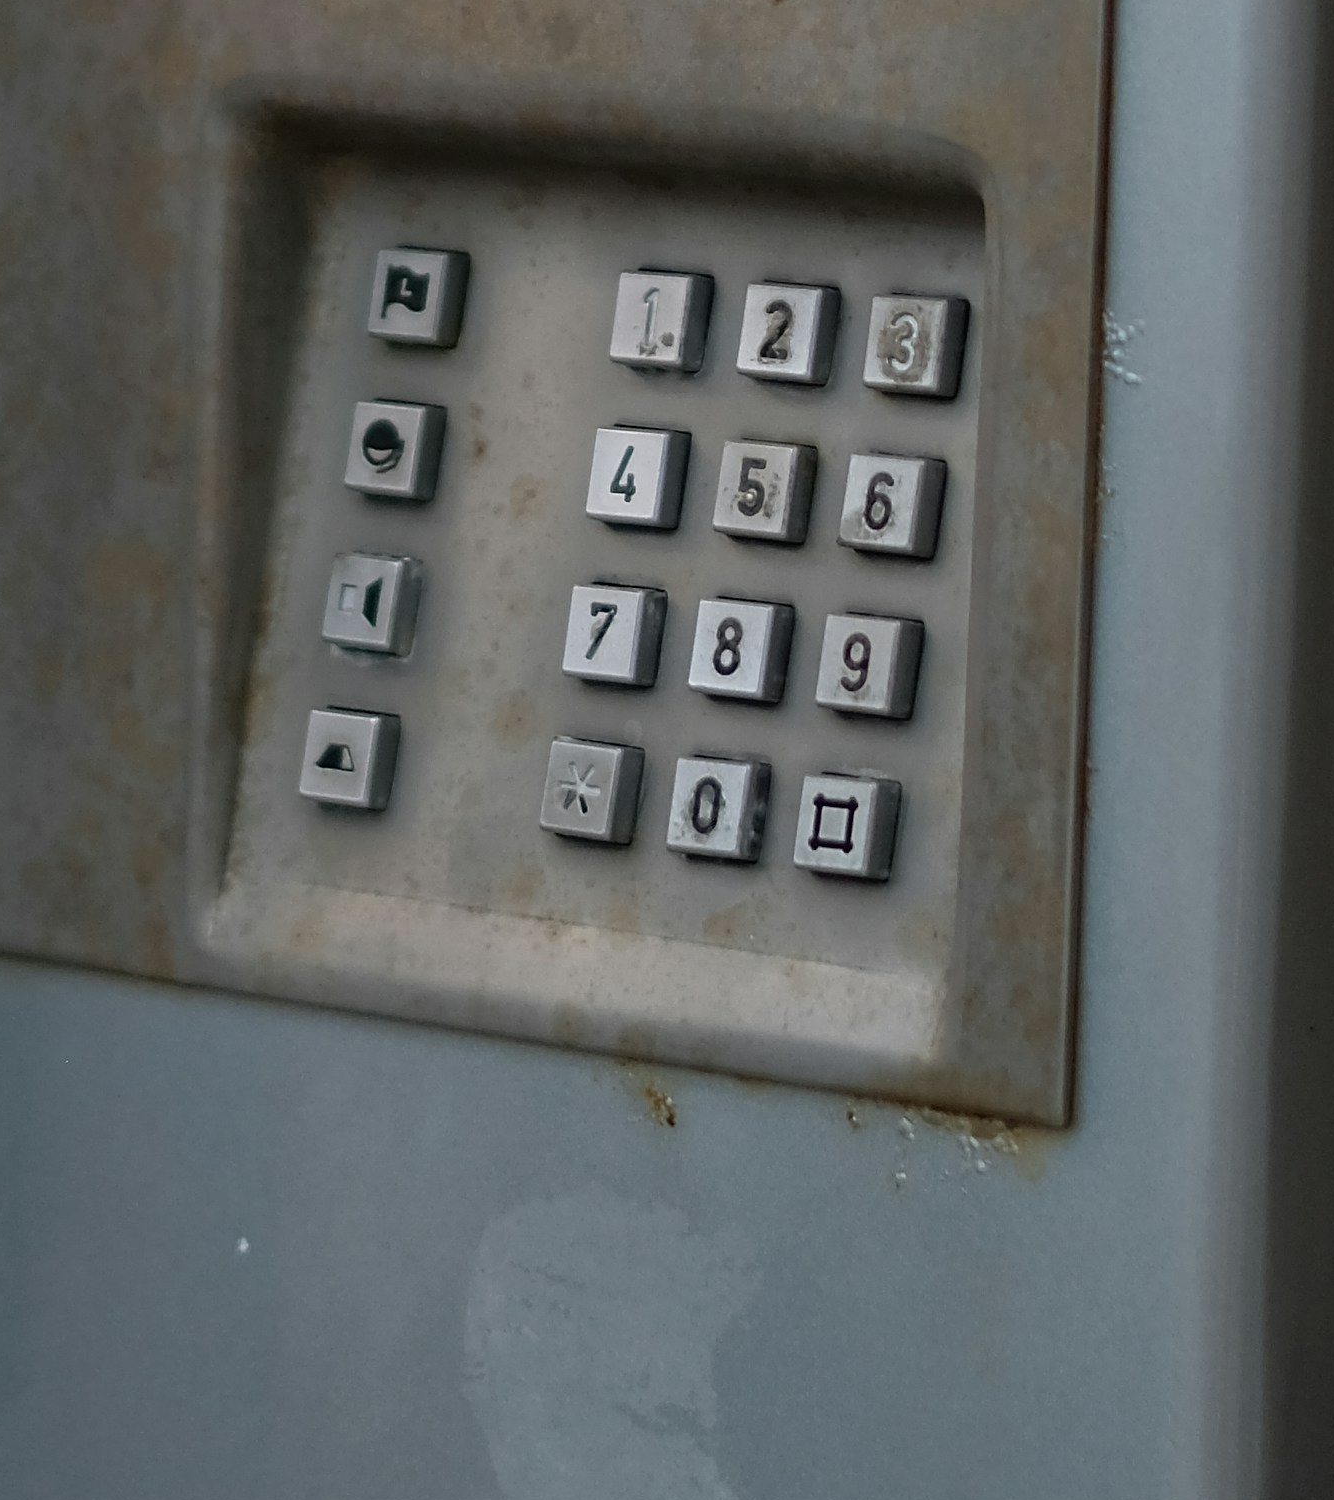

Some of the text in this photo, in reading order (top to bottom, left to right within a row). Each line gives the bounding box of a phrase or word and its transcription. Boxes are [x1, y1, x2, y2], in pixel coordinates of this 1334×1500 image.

[639, 287, 920, 373] 1 2 3
[610, 445, 895, 531] 4 5 6
[586, 602, 872, 691] 7 8 9
